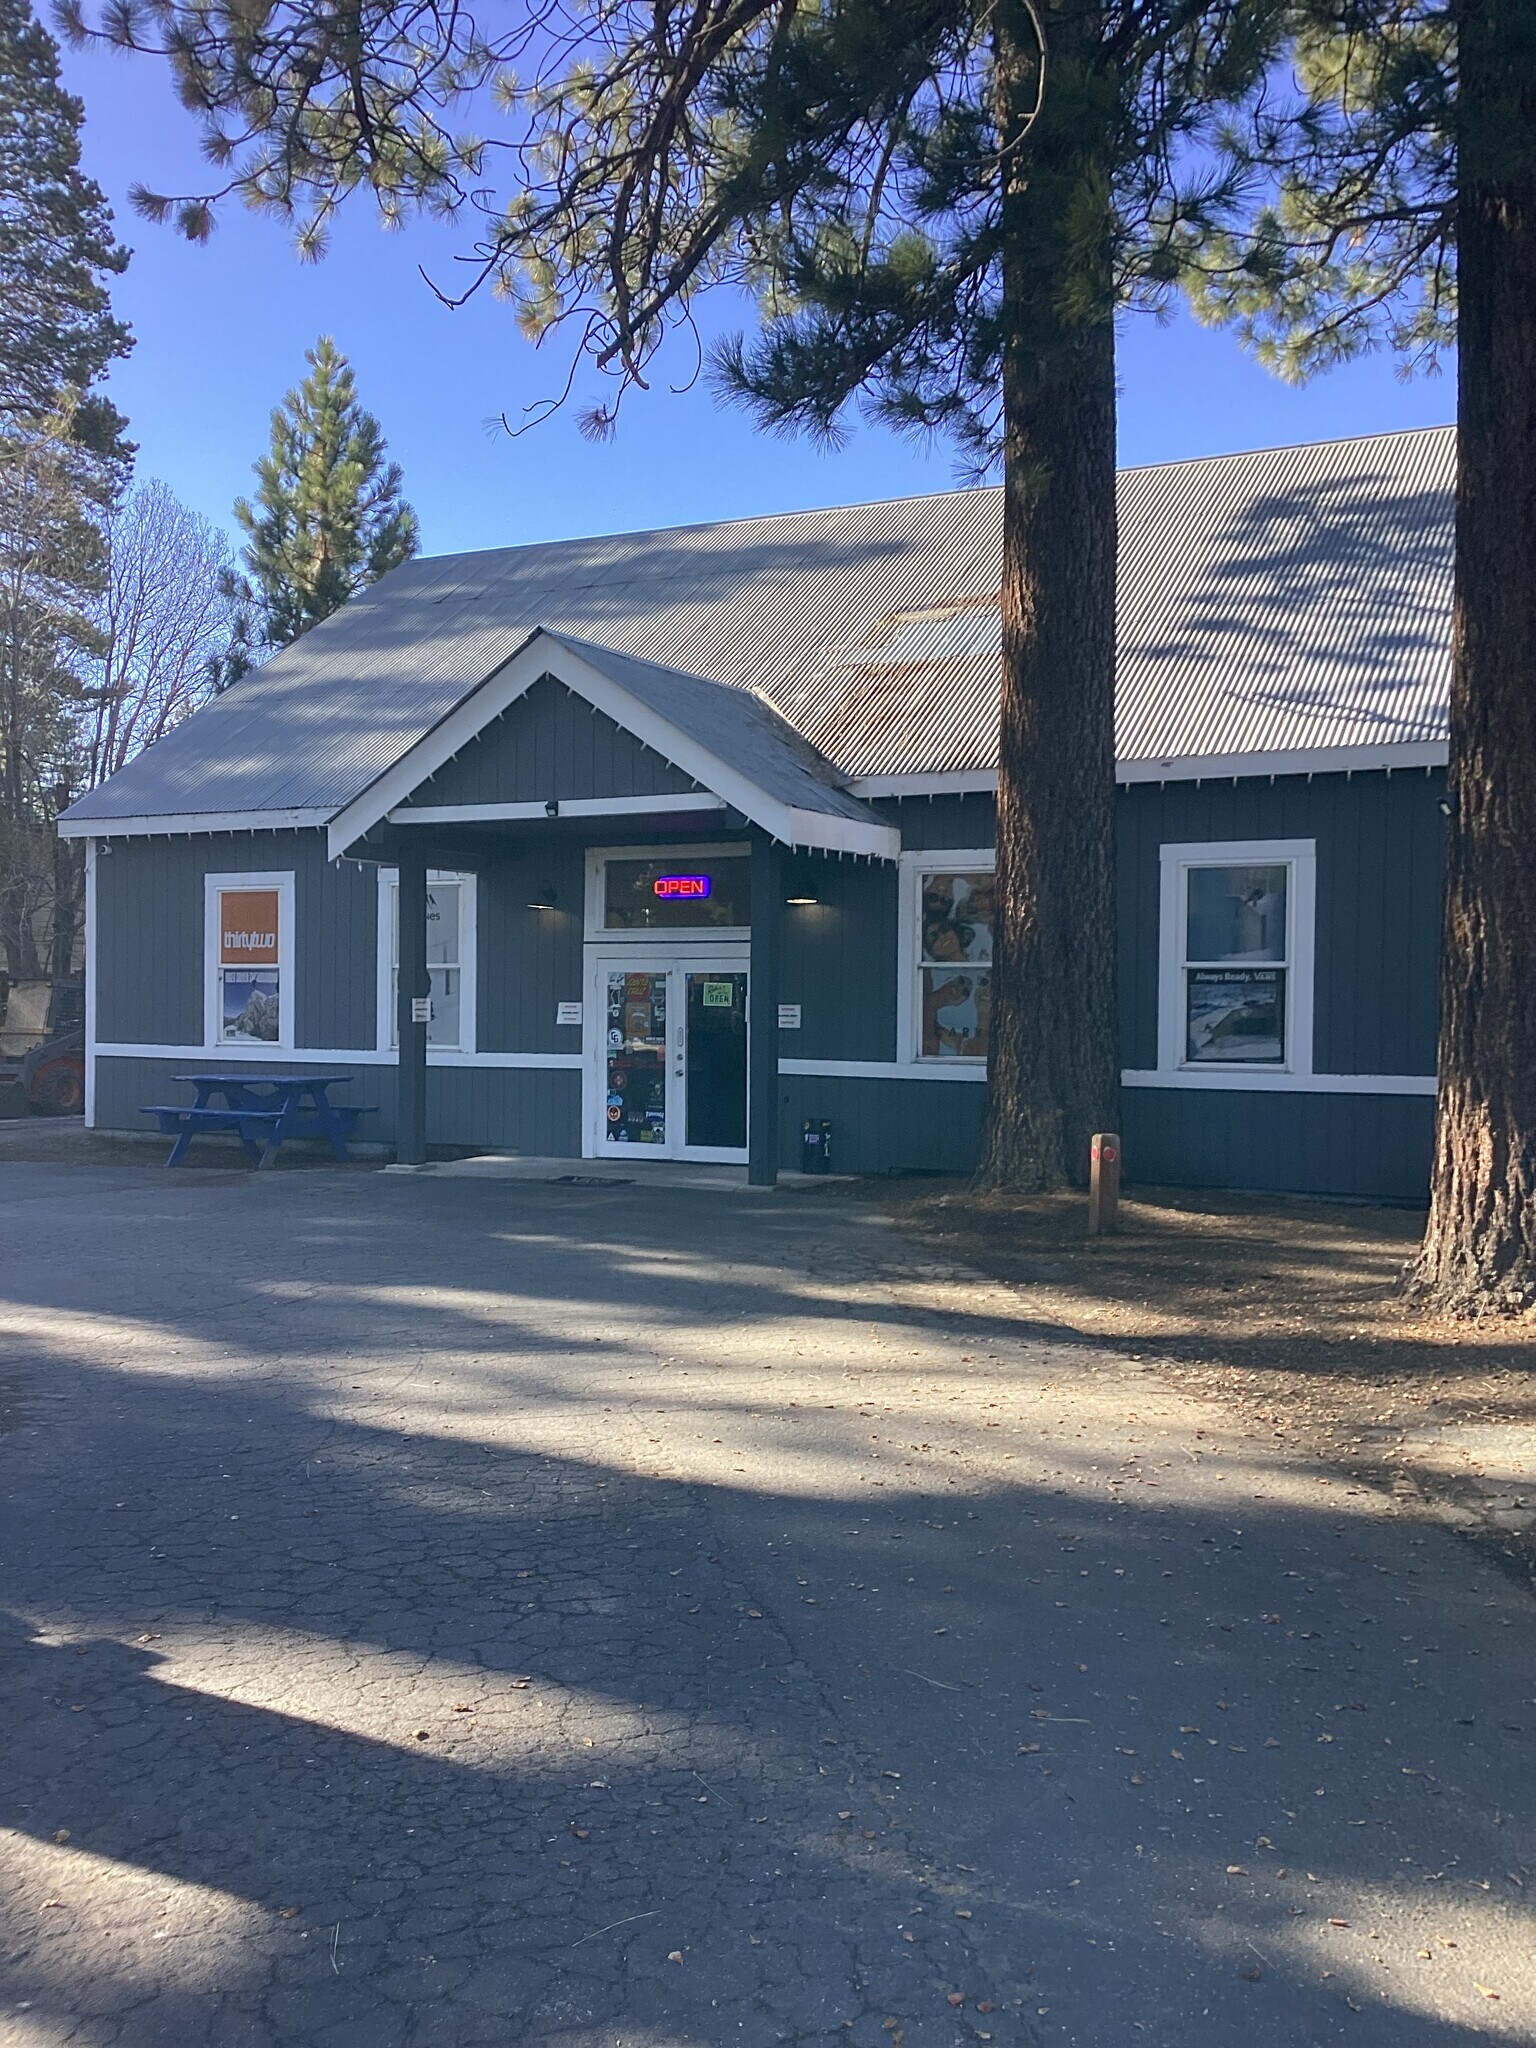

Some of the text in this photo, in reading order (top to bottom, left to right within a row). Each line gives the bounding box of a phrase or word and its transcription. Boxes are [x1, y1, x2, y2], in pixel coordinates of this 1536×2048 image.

[654, 880, 704, 894] OPEN
[224, 931, 275, 951] thirtytwo
[1196, 972, 1223, 983] Always
[627, 978, 649, 988] SANTA
[627, 987, 647, 996] CRUZ
[709, 994, 729, 1003] OPEN
